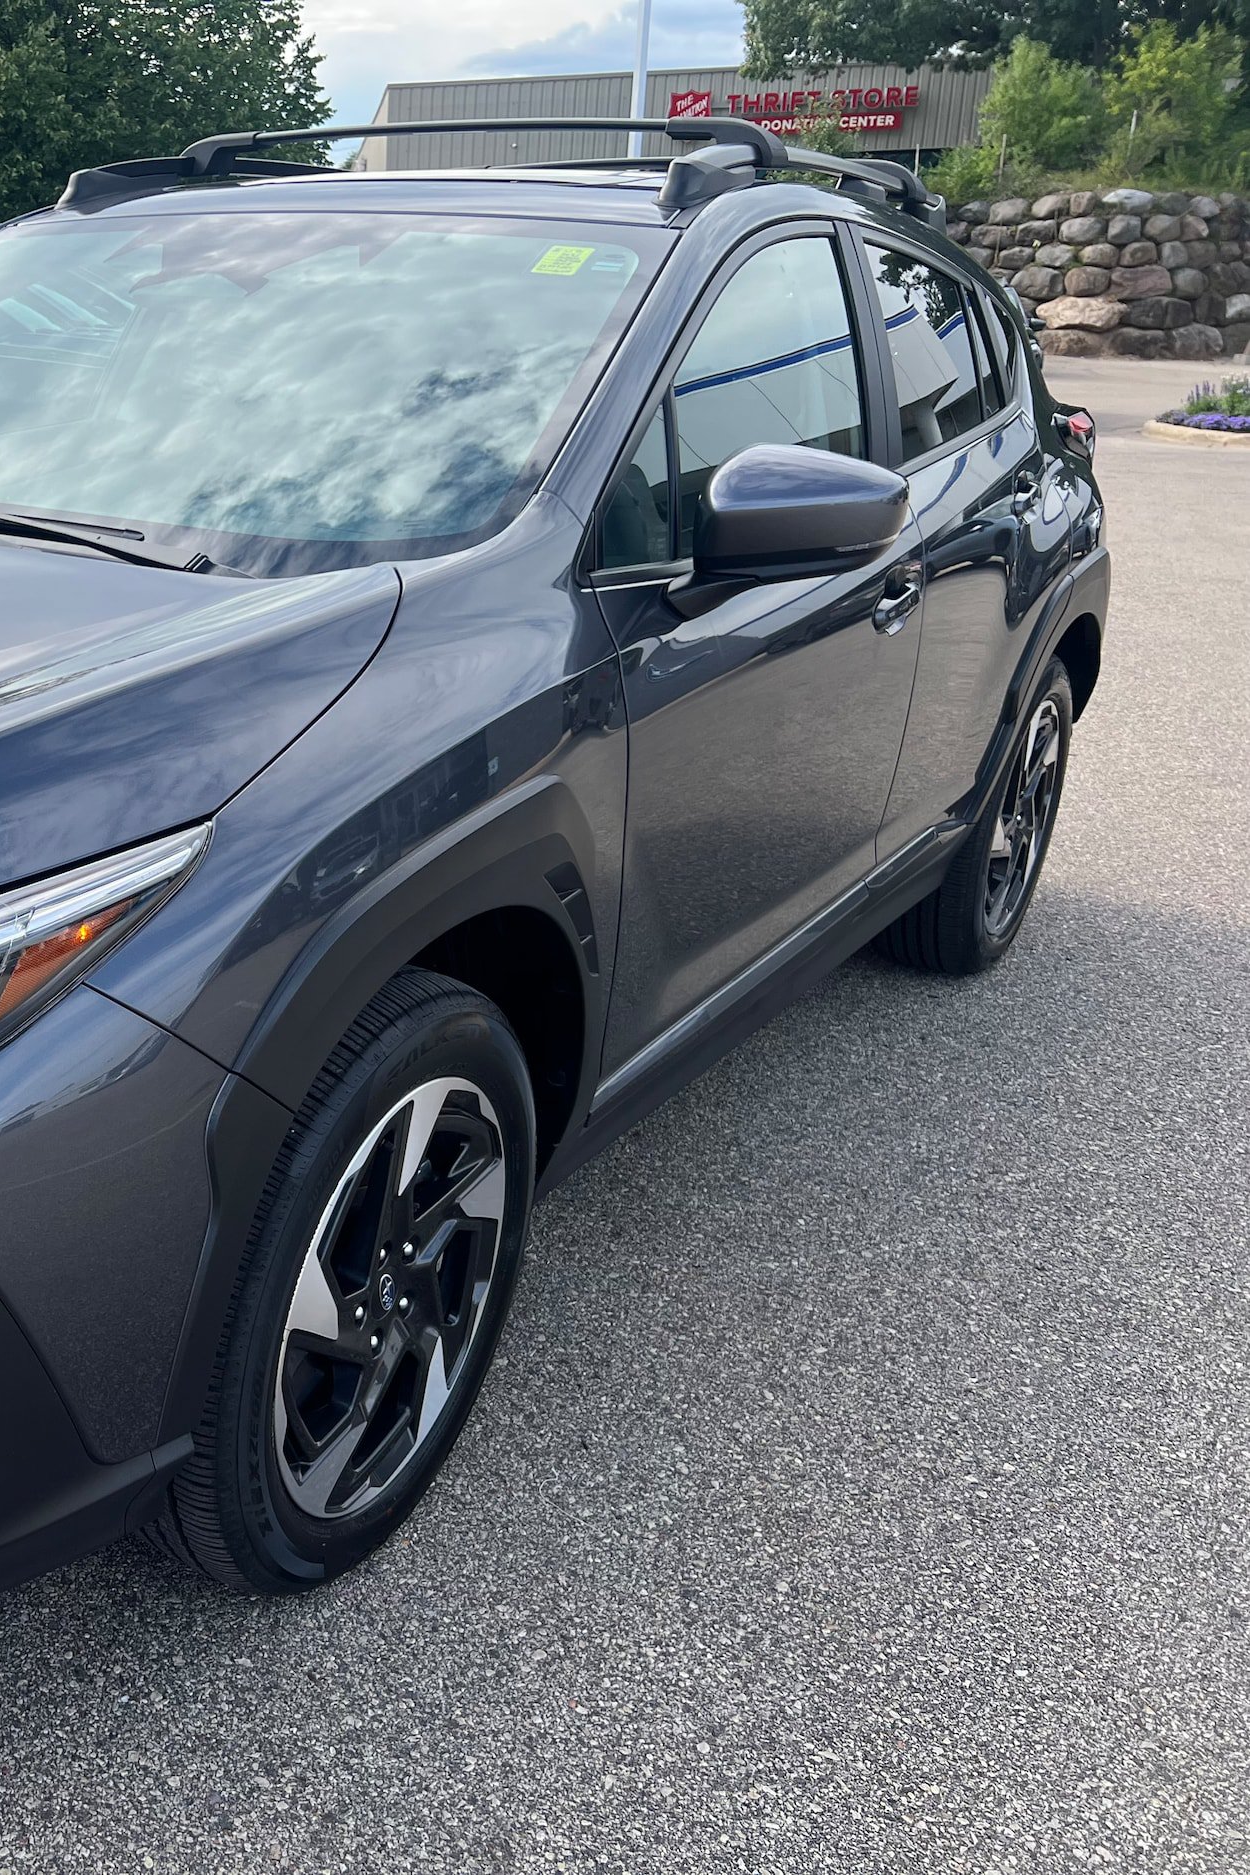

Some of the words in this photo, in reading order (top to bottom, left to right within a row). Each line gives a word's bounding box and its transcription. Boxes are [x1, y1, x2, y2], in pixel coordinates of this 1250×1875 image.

[675, 95, 694, 112] THE
[726, 91, 822, 114] THRIFT
[830, 86, 919, 109] STORE
[840, 115, 895, 128] CENTER
